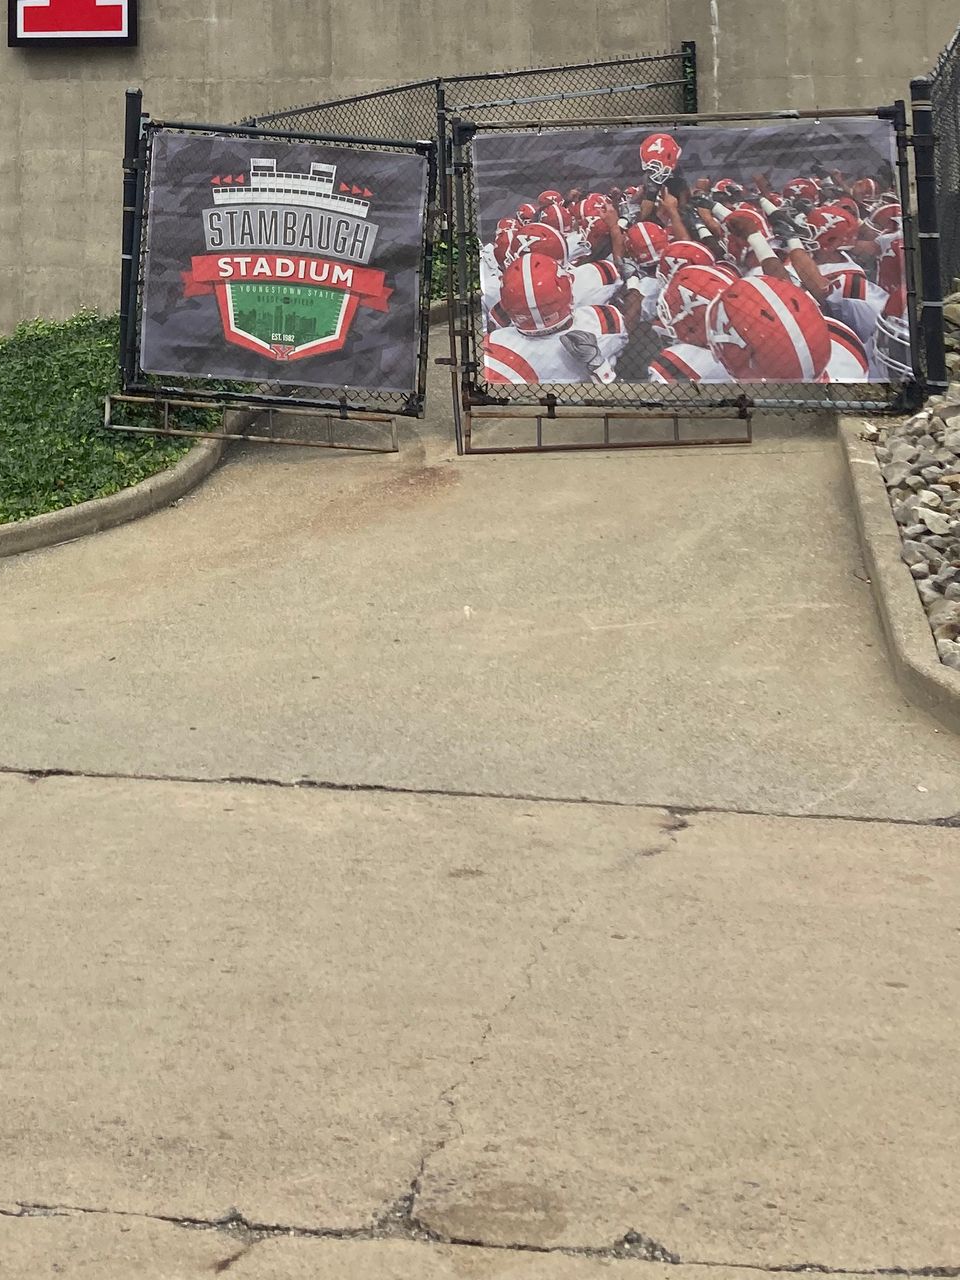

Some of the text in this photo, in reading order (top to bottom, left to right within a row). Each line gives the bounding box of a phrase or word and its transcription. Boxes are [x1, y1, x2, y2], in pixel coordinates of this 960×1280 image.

[207, 209, 371, 261] STAMBAUGH
[218, 257, 354, 287] STADIUM
[239, 285, 335, 300] YOUNGSTOWN STATE
[271, 332, 282, 341] EST.
[271, 343, 296, 361] Y
